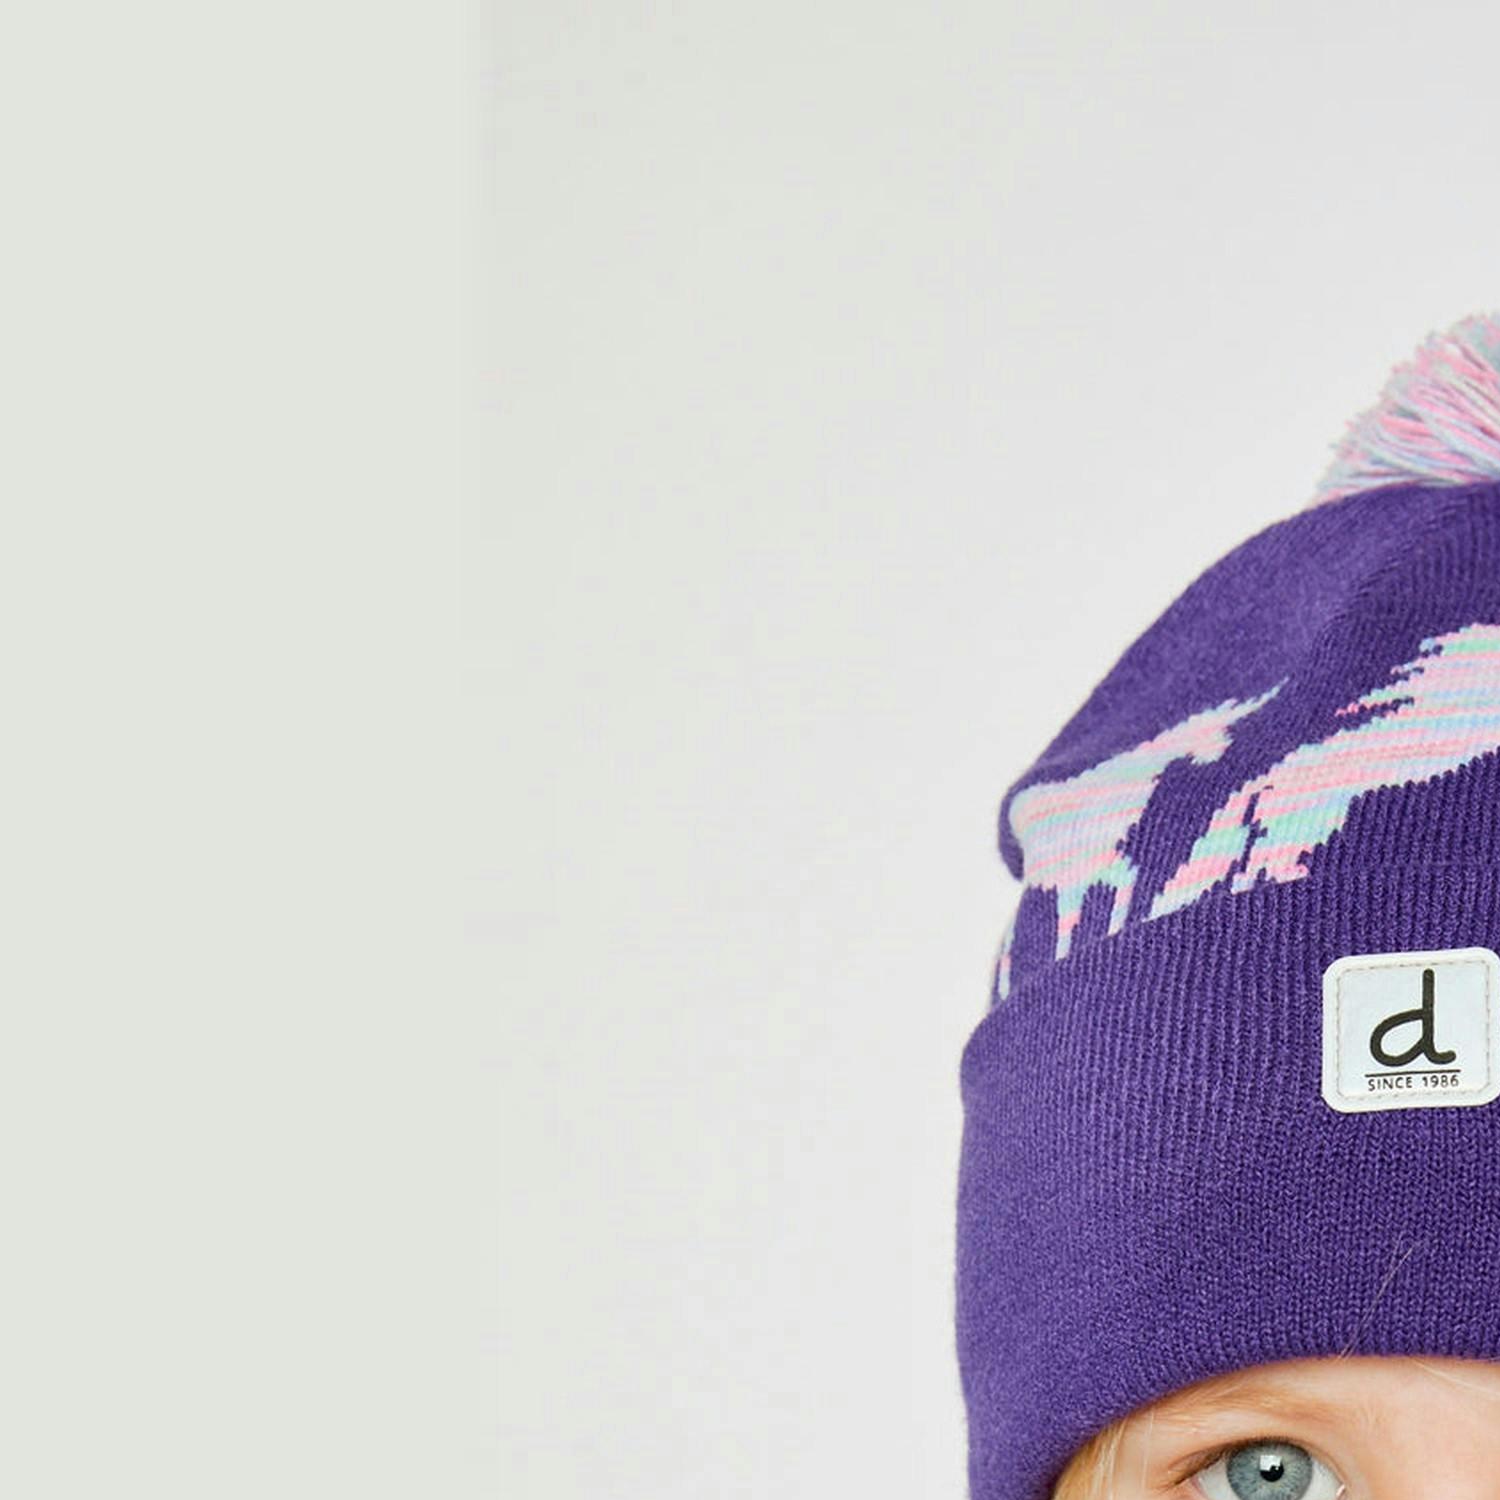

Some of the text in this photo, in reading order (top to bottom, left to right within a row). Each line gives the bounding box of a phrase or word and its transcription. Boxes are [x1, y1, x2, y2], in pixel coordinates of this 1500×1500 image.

[1370, 969, 1457, 1067] d
[1368, 1074, 1460, 1092] SINCE 1986
